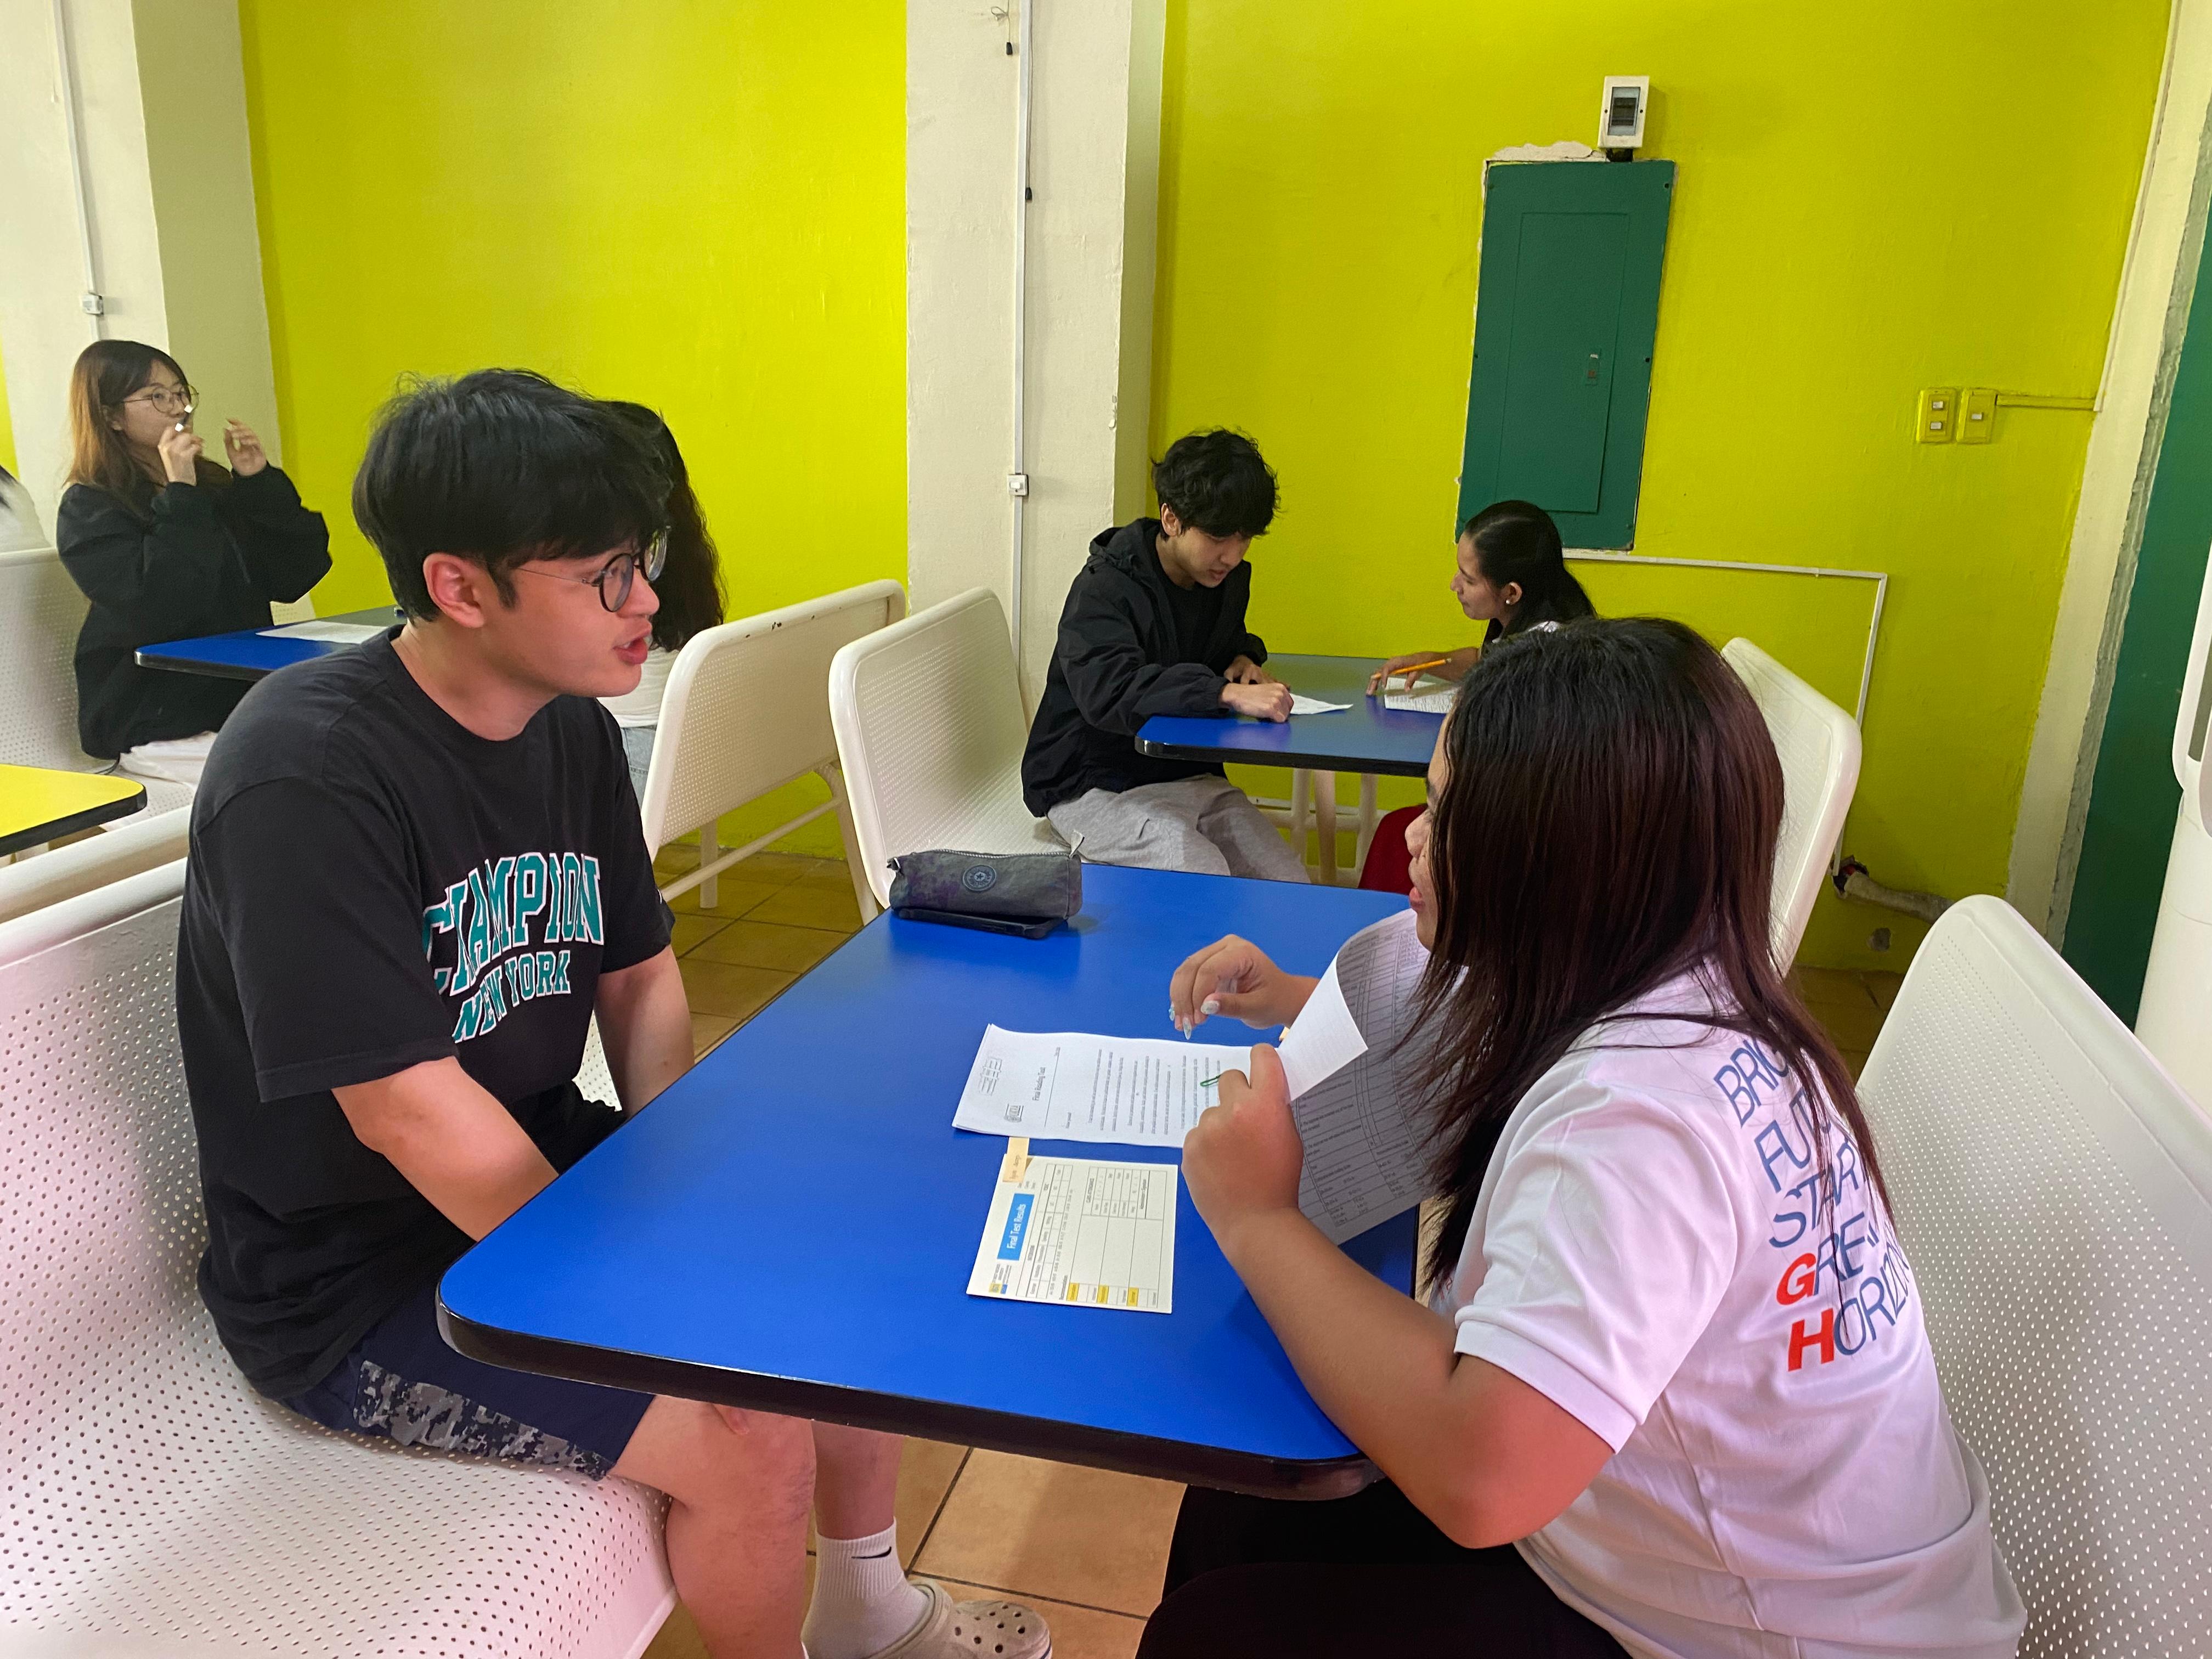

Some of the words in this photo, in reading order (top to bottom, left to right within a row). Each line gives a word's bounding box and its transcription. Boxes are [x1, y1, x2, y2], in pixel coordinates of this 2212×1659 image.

[452, 964, 507, 1043] NEW
[504, 950, 571, 1008] YORK
[1713, 1034, 1790, 1128] BRIG
[1013, 1204, 1026, 1222] Results
[1010, 1223, 1022, 1234] Test
[1006, 1235, 1018, 1249] Final
